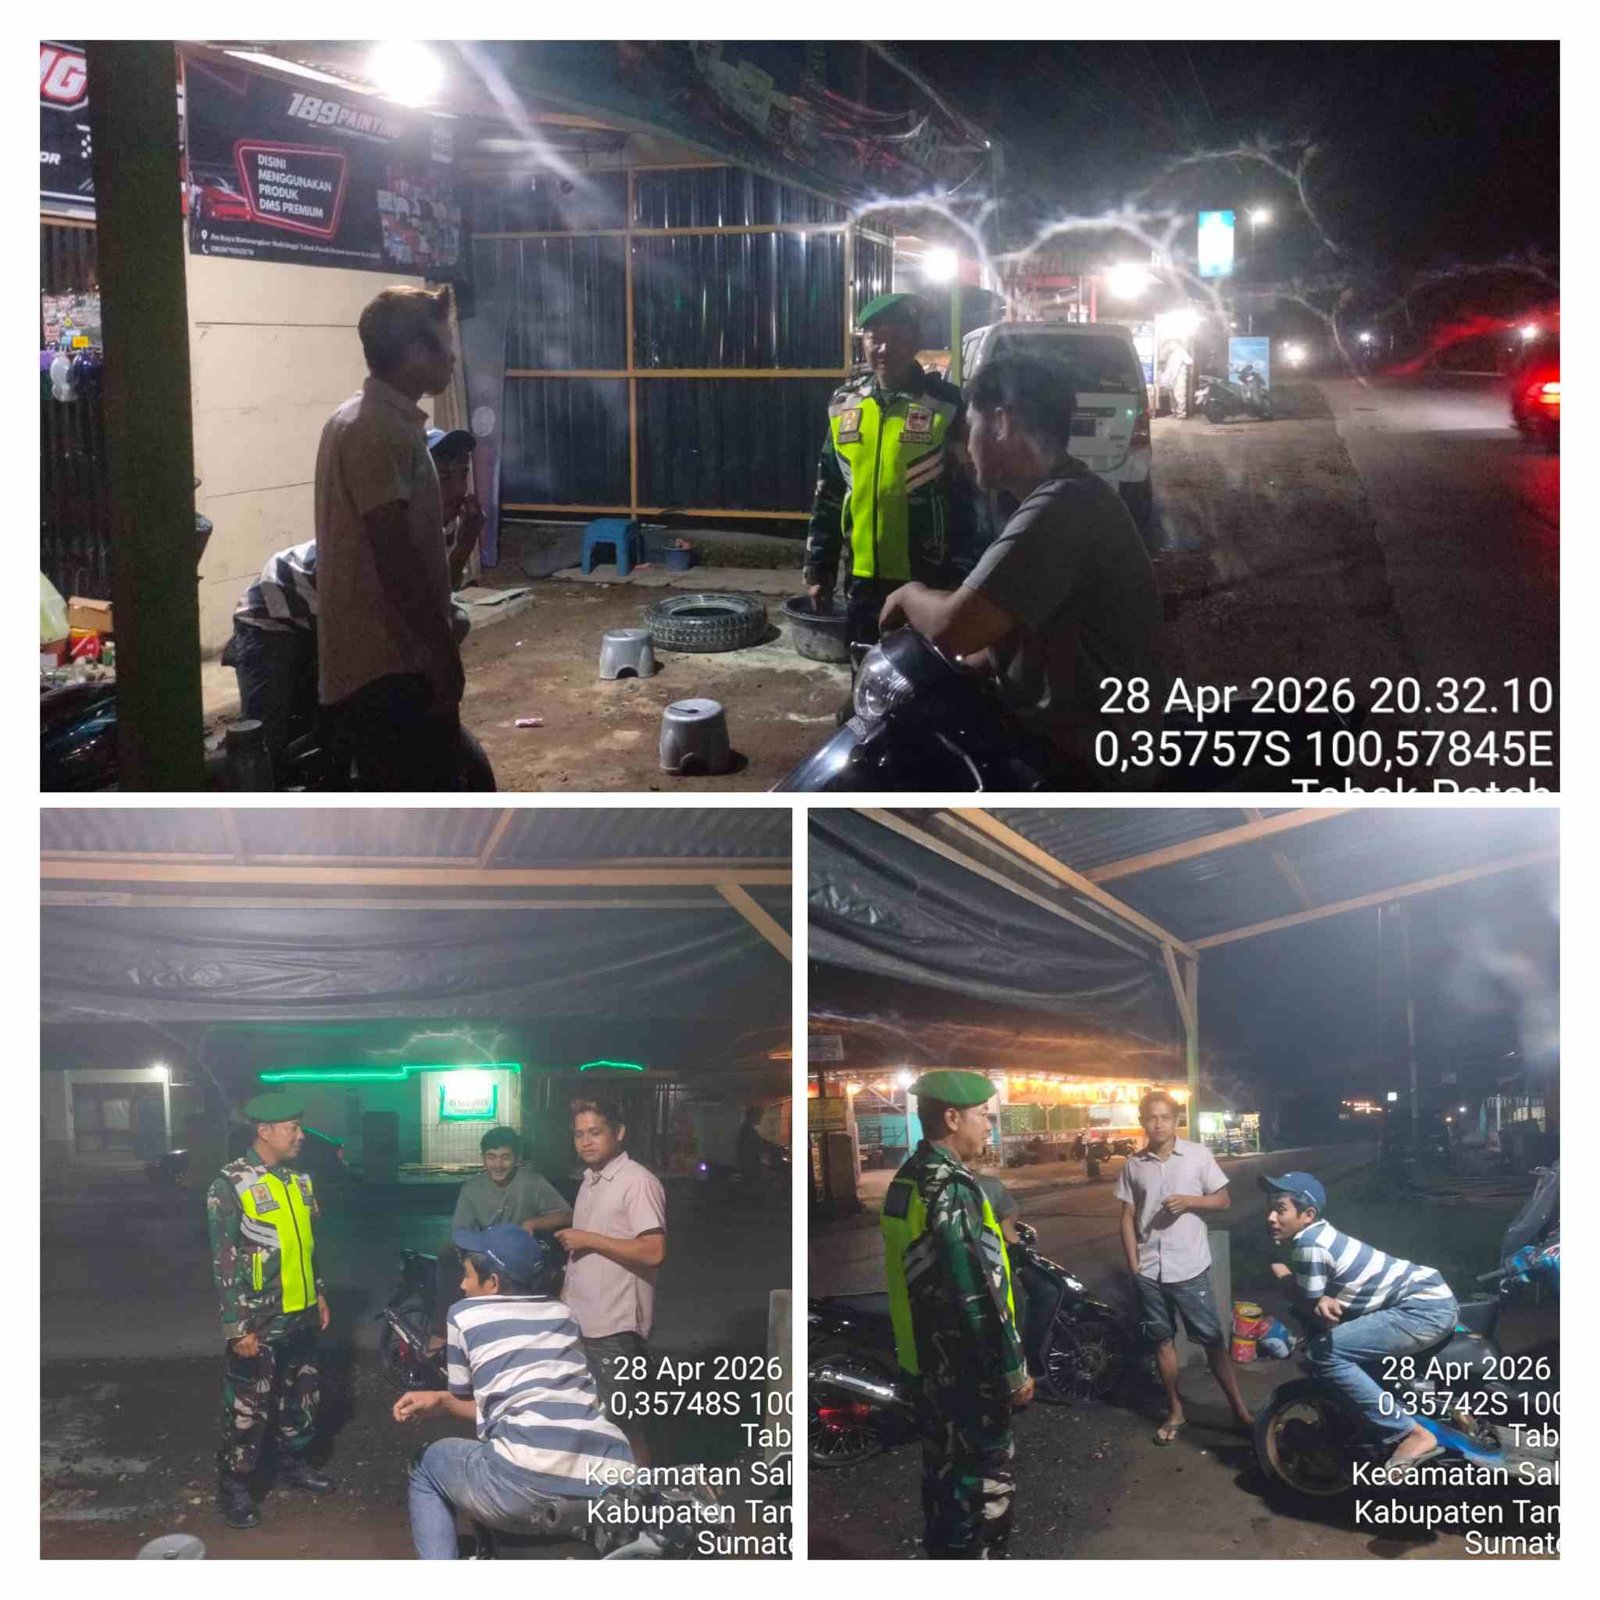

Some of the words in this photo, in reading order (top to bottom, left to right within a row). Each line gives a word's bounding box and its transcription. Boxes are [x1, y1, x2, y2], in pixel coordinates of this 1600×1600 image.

[287, 92, 340, 125] 189
[258, 153, 287, 169] DISINI
[258, 169, 332, 193] MENGGUNAKAN
[258, 184, 299, 200] PRODUK
[259, 198, 281, 212] DMS
[282, 201, 324, 217] PREMIUM
